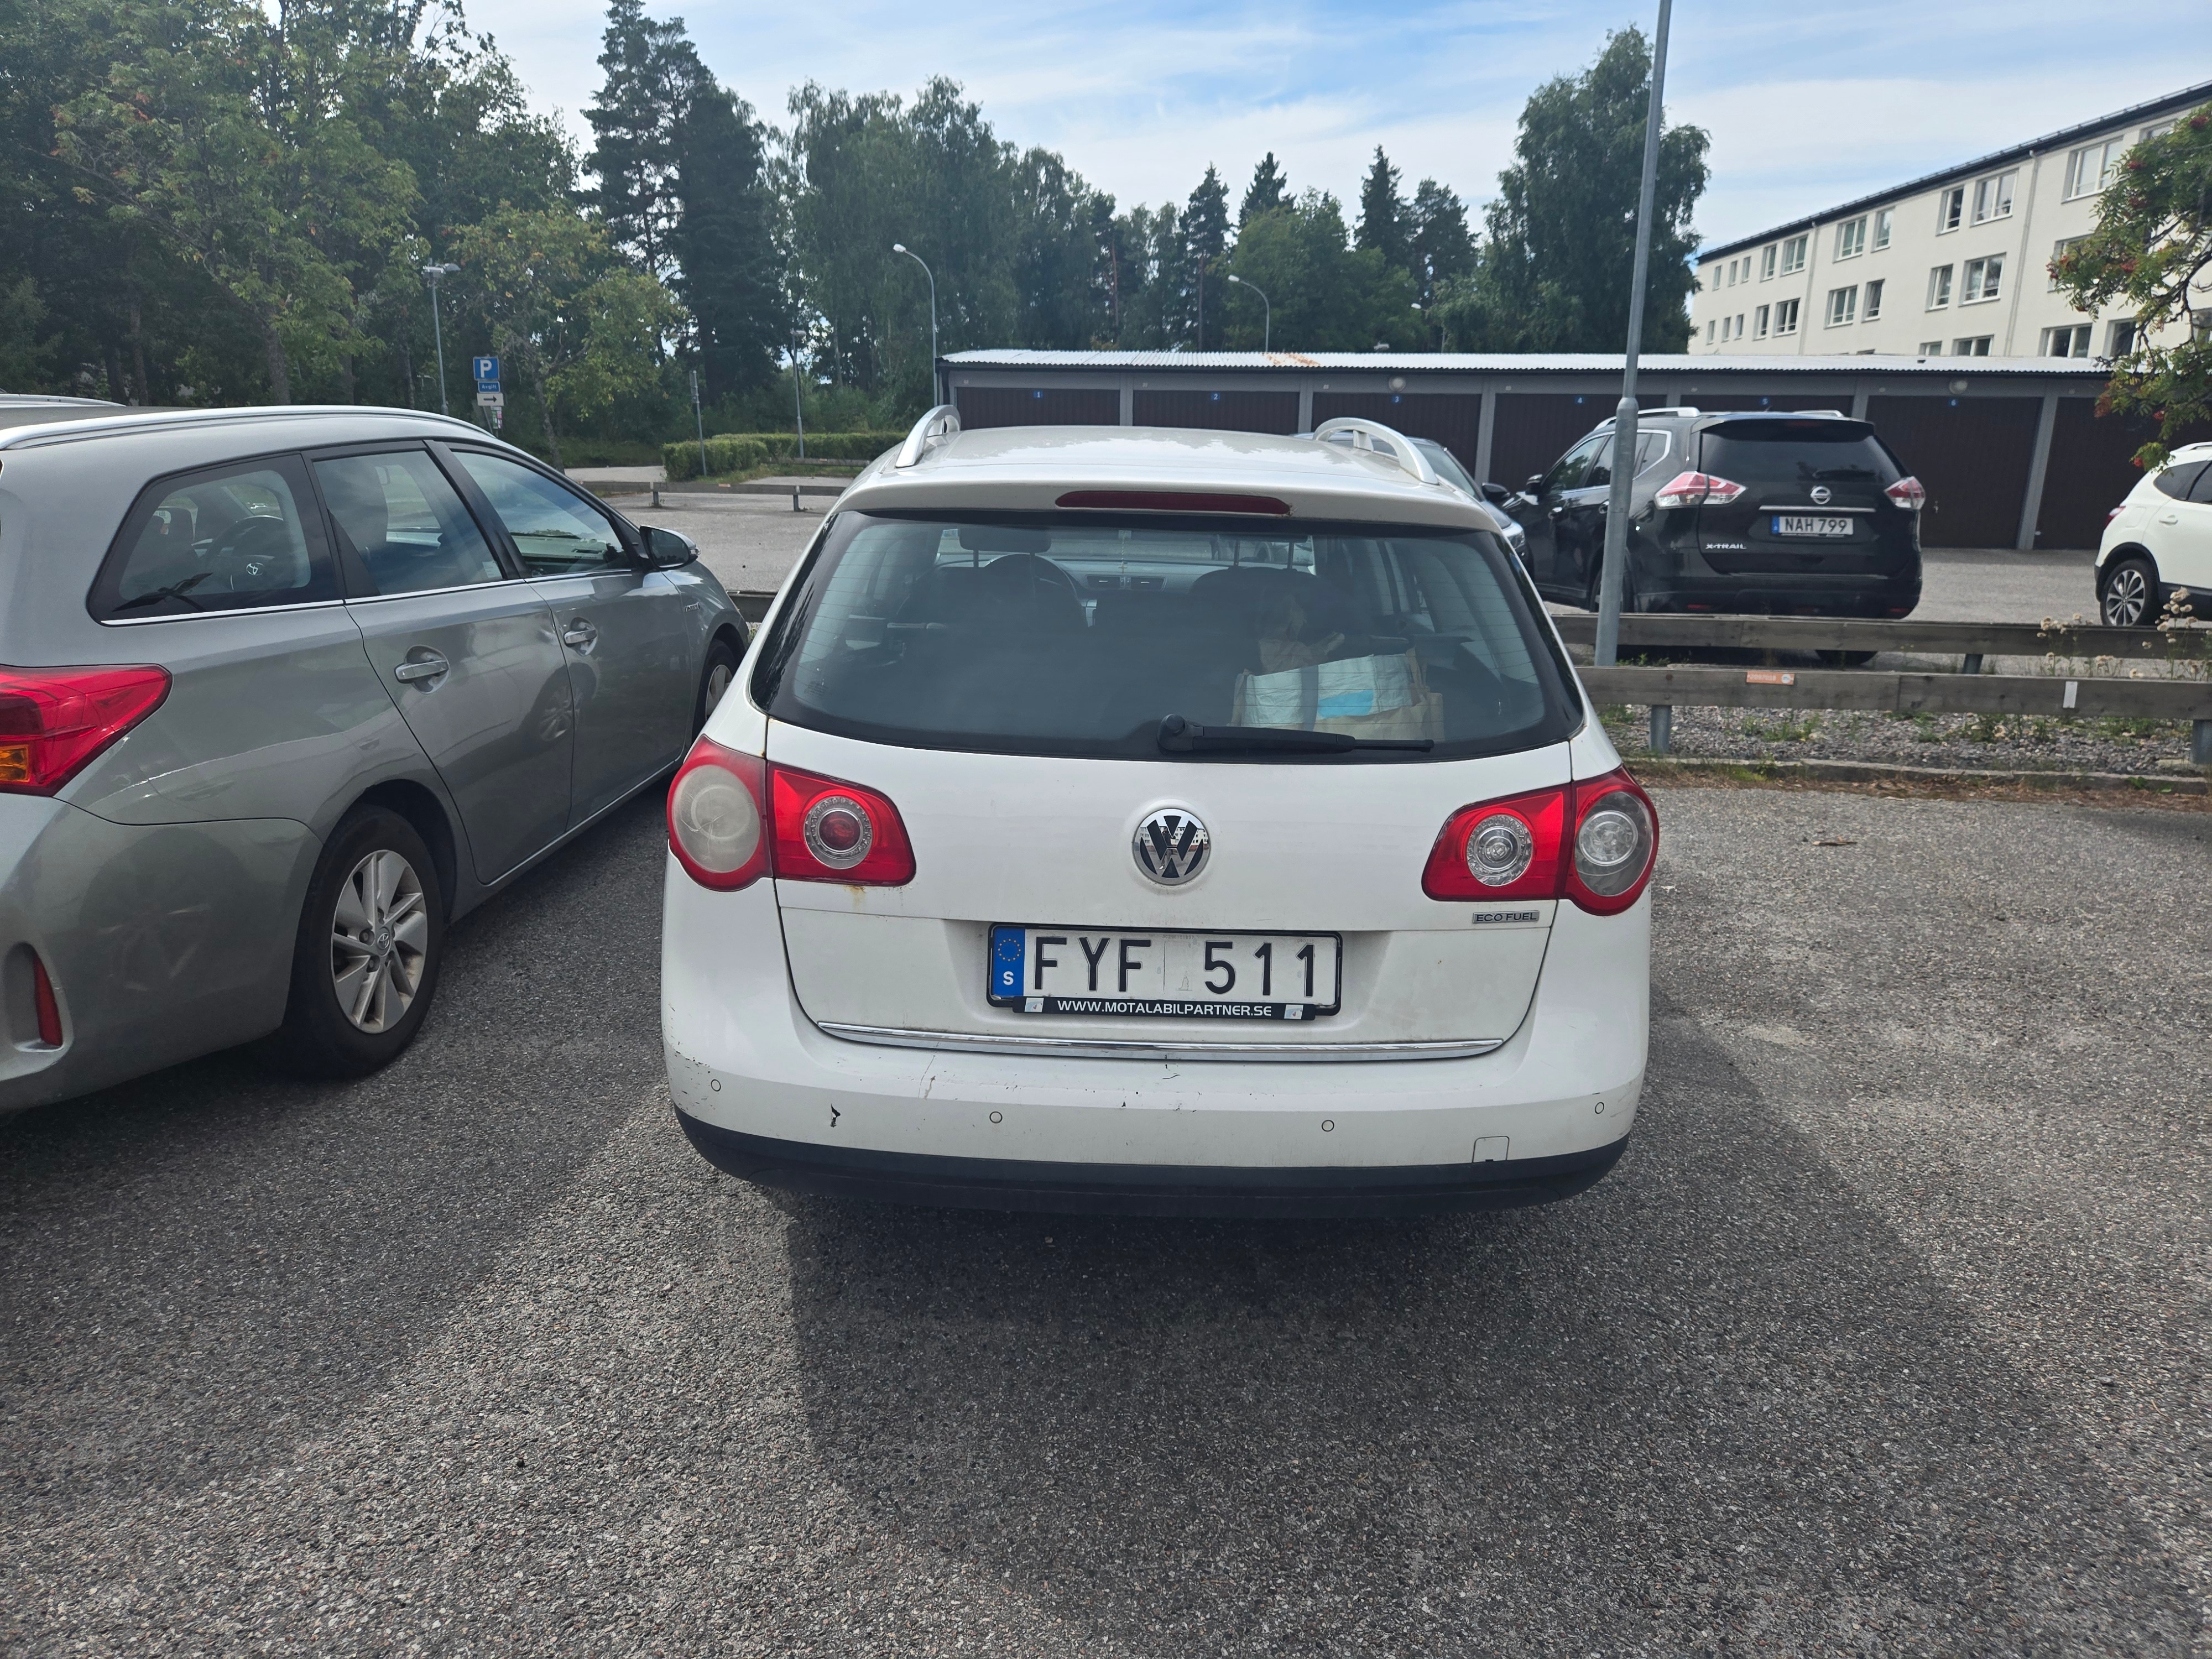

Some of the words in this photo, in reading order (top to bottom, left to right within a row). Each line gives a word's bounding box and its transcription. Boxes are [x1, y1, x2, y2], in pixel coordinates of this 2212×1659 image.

[480, 359, 492, 378] P
[1785, 518, 1814, 531] NAH
[1818, 519, 1847, 533] 799
[1035, 936, 1151, 992] FYF
[1204, 941, 1314, 998] 511
[1003, 971, 1014, 985] S
[1057, 1000, 1272, 1016] WWW.MOTALABILPARTNER.SE
